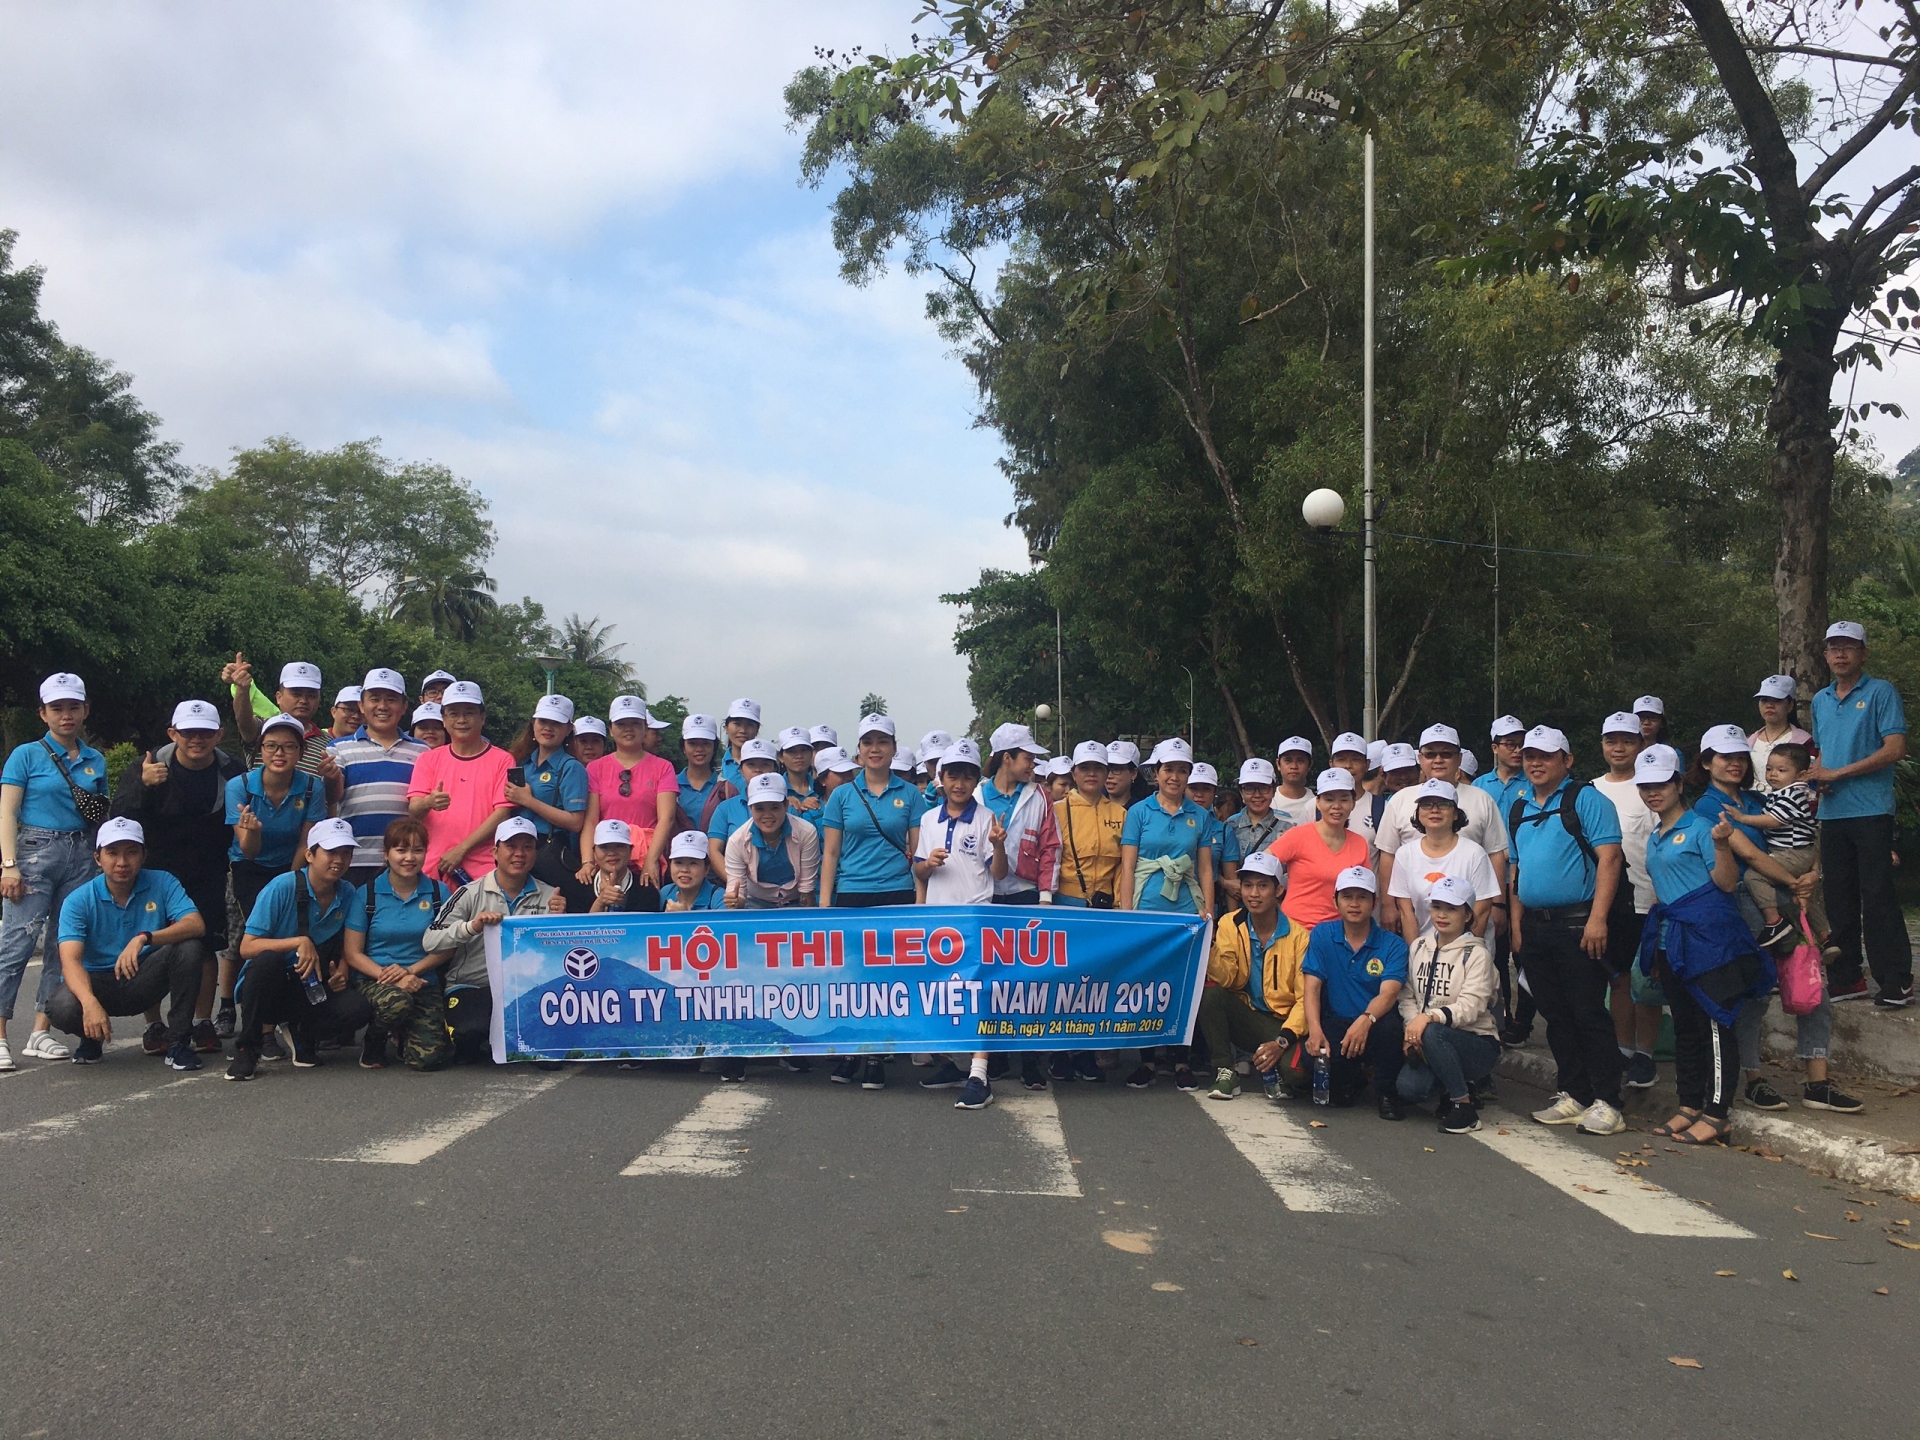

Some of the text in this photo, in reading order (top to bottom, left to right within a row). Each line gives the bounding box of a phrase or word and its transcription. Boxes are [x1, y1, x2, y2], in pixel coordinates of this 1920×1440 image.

[647, 920, 1068, 981] HỘI THI LEO NÚI
[540, 972, 1172, 1027] CÔNG TY TNHH POU HUNG VIỆT NAM NĂM 2019
[1417, 977, 1451, 997] THREE
[978, 1018, 1164, 1038] Núi Bà, ngày 24 tháng 11 năm 2019
